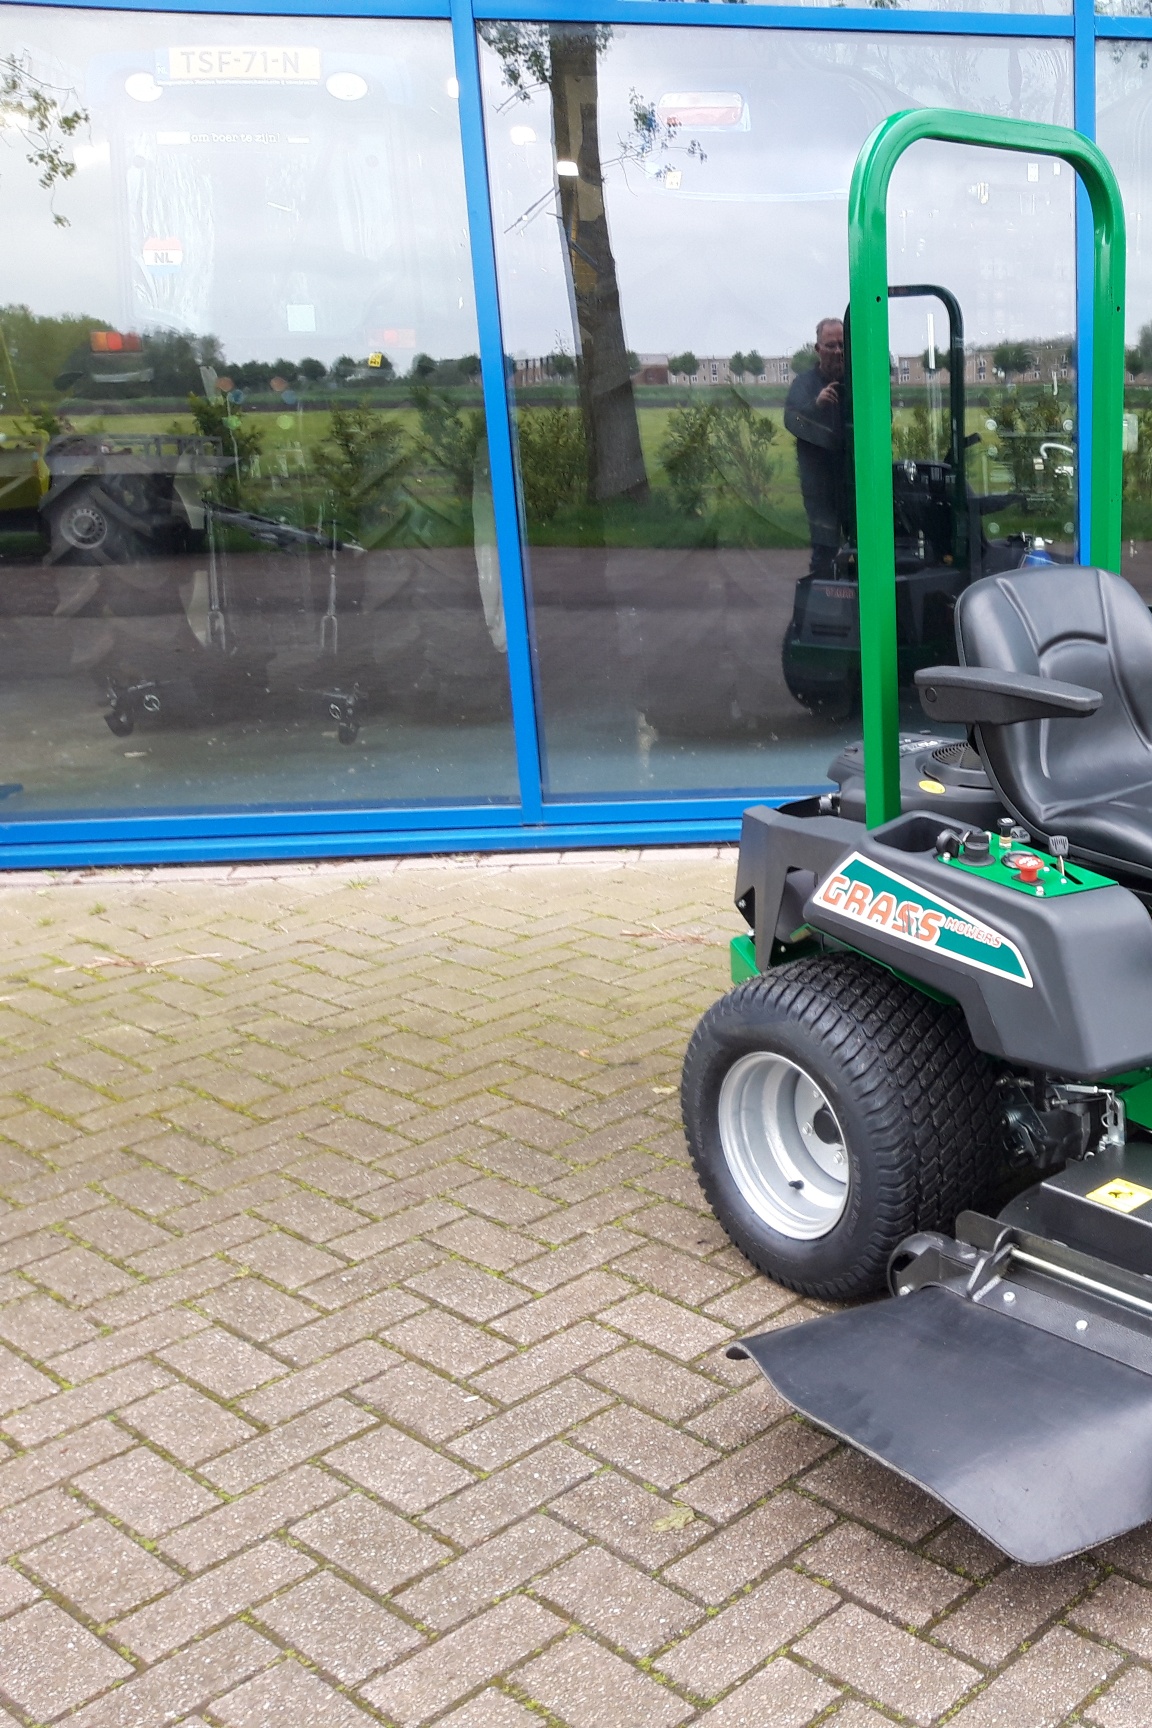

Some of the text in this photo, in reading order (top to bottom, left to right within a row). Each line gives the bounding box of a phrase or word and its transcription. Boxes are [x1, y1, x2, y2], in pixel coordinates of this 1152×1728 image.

[180, 50, 300, 74] TSF-71-N
[211, 132, 238, 143] boer
[154, 252, 173, 264] NL
[821, 875, 1002, 948] GRASS MOWERS
